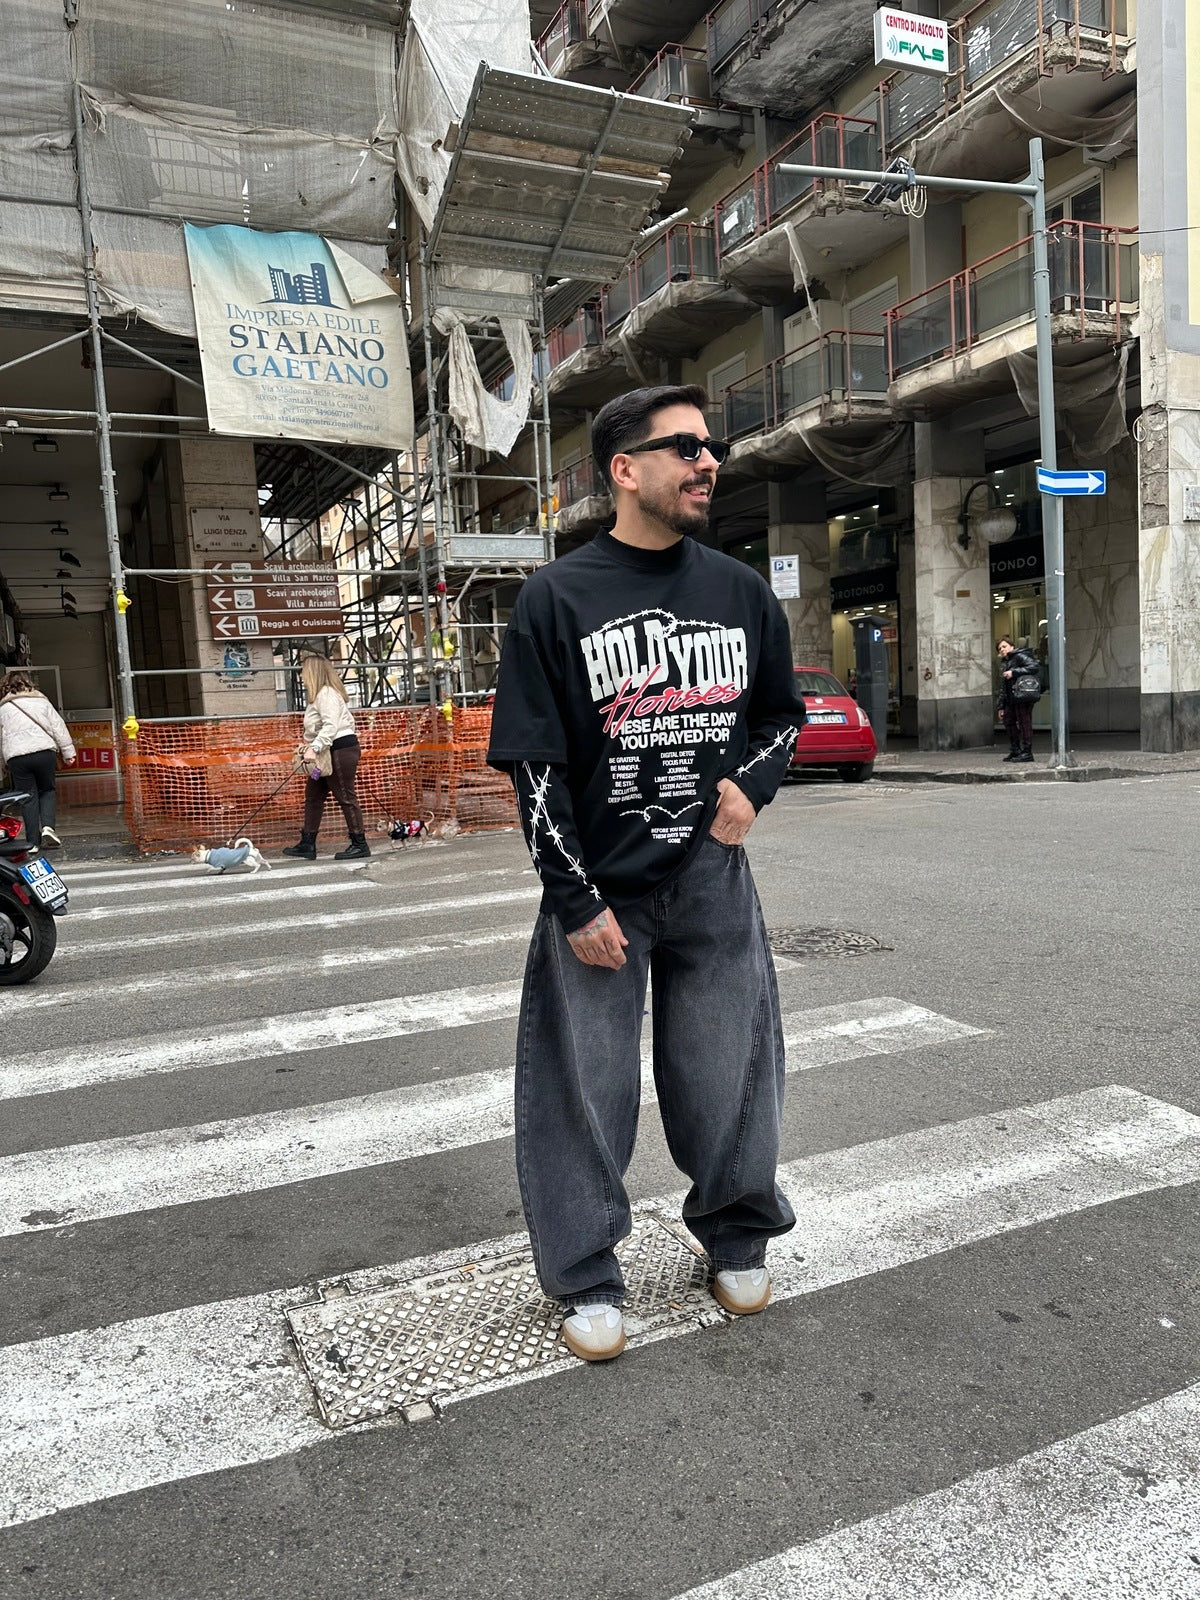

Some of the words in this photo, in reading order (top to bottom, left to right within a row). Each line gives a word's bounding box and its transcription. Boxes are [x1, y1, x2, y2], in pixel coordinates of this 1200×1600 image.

[886, 15, 910, 31] CENTRO
[911, 21, 916, 33] DI
[918, 23, 944, 39] ASCOLTO
[226, 303, 324, 327] IMPRESA
[324, 313, 382, 335] EDILE
[229, 324, 385, 361] STAIANO
[232, 354, 389, 389] GAETANO
[262, 384, 274, 393] Via
[276, 386, 311, 395] Madonna
[264, 562, 285, 571] Scavi
[288, 562, 333, 571] archeologici
[776, 562, 783, 570] P
[991, 556, 1037, 573] TONDO
[272, 574, 291, 582] Villa
[266, 589, 287, 598] Scavi
[290, 588, 336, 598] archeologici
[286, 600, 305, 608] Villa
[309, 600, 337, 608] Arianna
[261, 620, 290, 629] Reggia
[302, 619, 341, 627] Quisisana
[874, 629, 882, 642] P
[580, 619, 670, 702] HOLD
[668, 627, 748, 693] YOUR
[599, 664, 743, 738] Horses
[653, 715, 680, 732] ARE
[680, 712, 710, 728] THE
[711, 712, 737, 727] DAYS
[620, 735, 649, 750] YOU
[650, 729, 704, 747] PRAYED
[705, 728, 730, 742] FOR
[616, 756, 641, 764] GRATEFUL
[618, 764, 640, 772] MINDFUL
[667, 766, 690, 774] JOURNAL
[668, 773, 701, 782] DISTRACTIONS
[612, 786, 639, 796] DECLUTTER
[673, 789, 697, 797] MEMORIES
[28, 863, 45, 879] EZ
[36, 876, 64, 899] 07530
